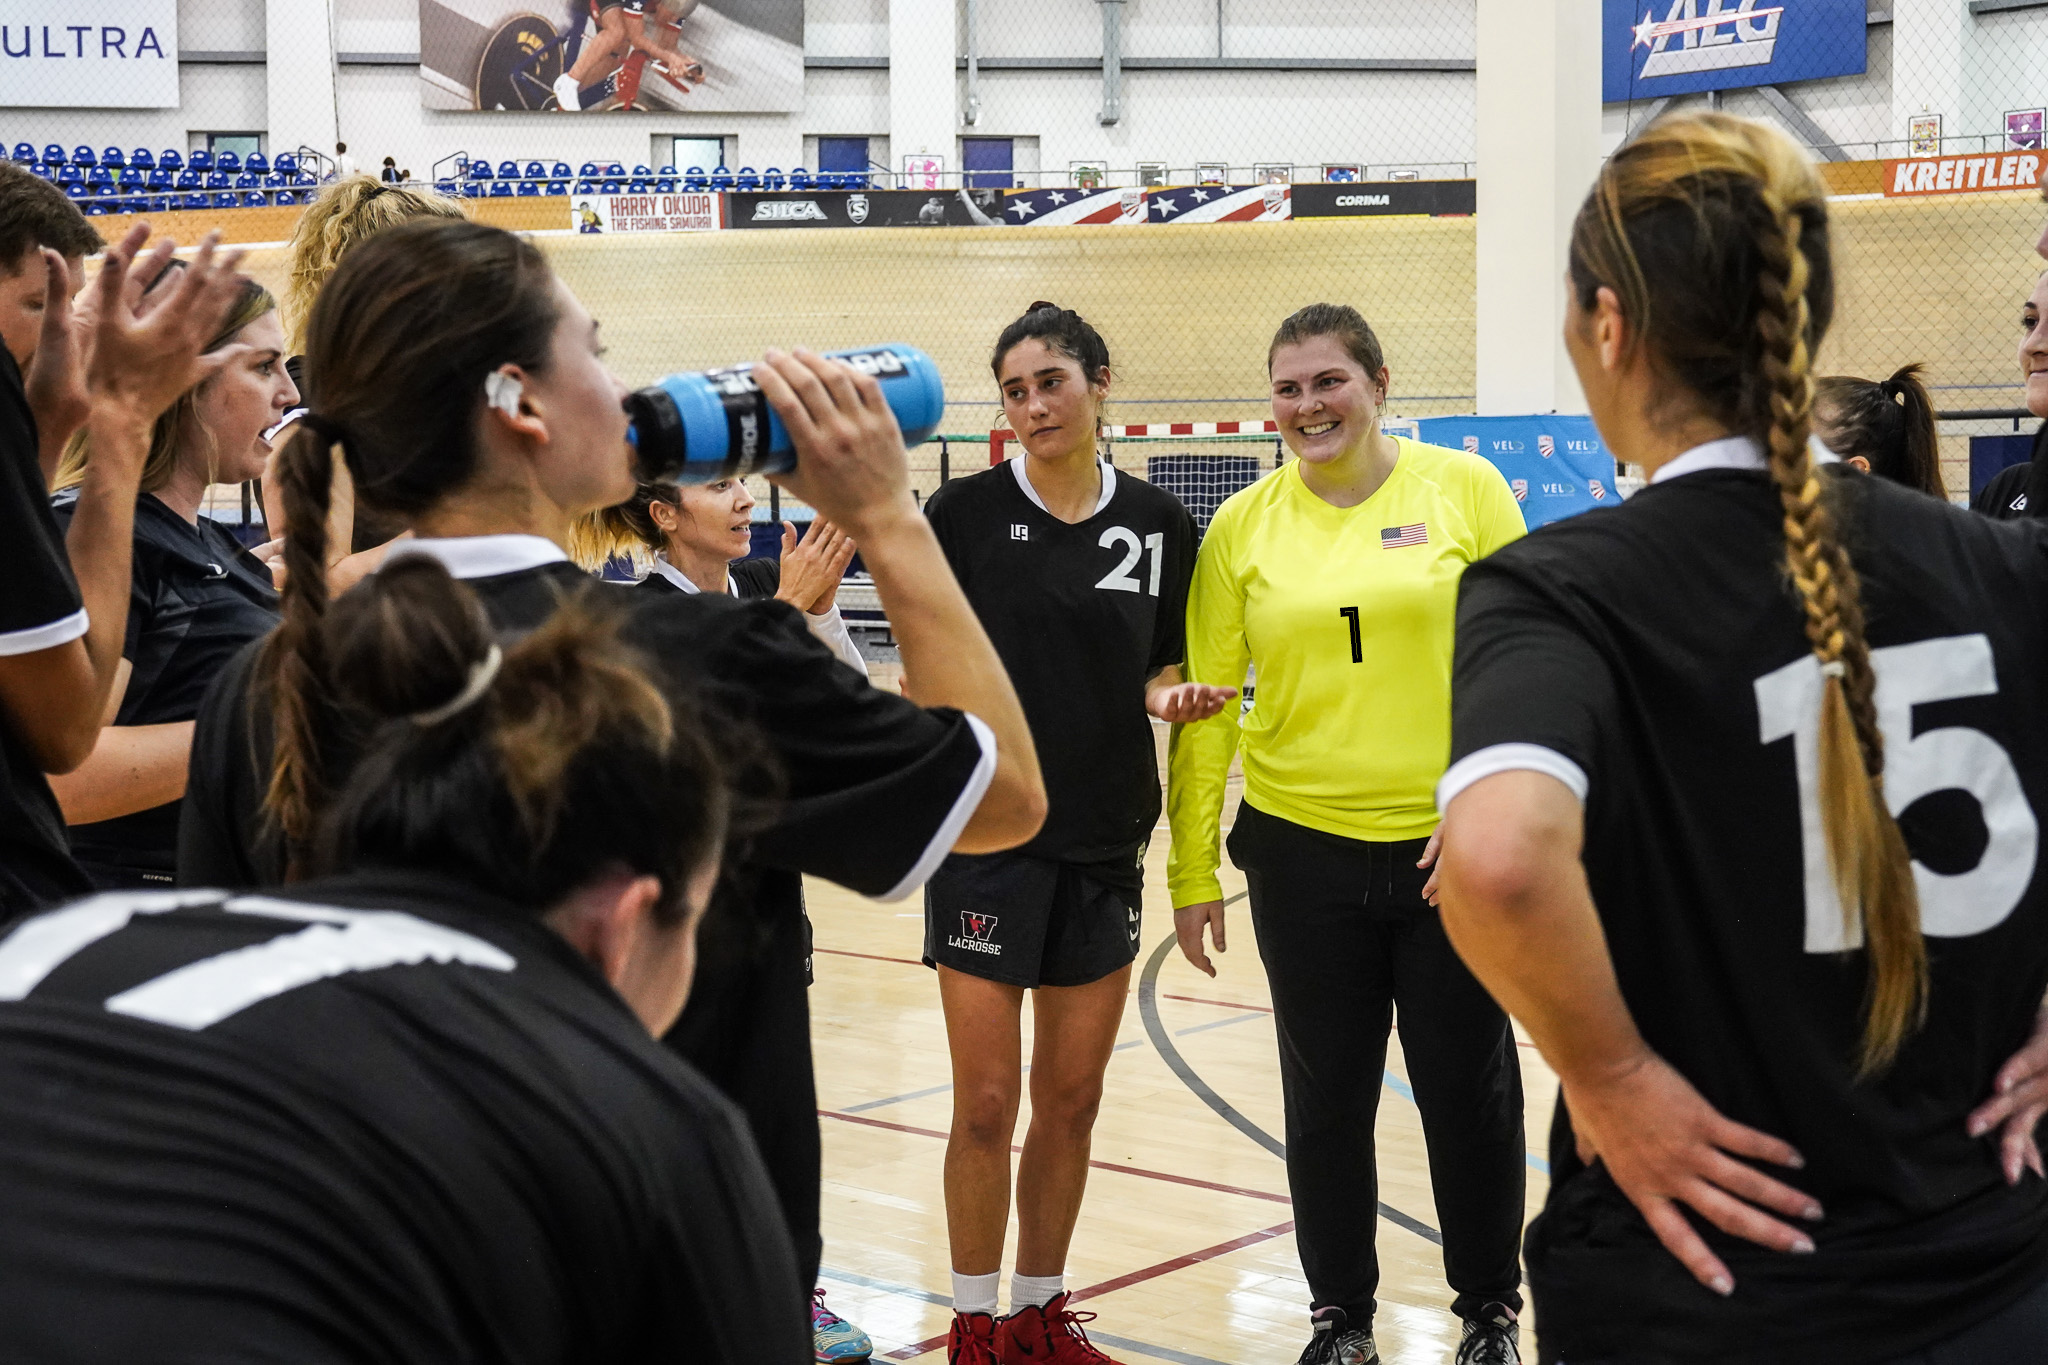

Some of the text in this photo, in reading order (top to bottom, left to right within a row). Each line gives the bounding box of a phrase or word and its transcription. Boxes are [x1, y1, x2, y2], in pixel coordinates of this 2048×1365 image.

[2, 25, 164, 58] ULTRA
[1893, 155, 2039, 193] KREITLER
[610, 195, 711, 217] HARRY OKUDA
[753, 201, 826, 220] SILCA
[1335, 194, 1390, 207] CORIMA
[611, 216, 712, 231] THE FISHING SAMURAI
[1095, 526, 1164, 597] 21
[1340, 607, 1363, 664] 1
[1753, 633, 2039, 953] 15
[948, 934, 1002, 956] LACROSSE
